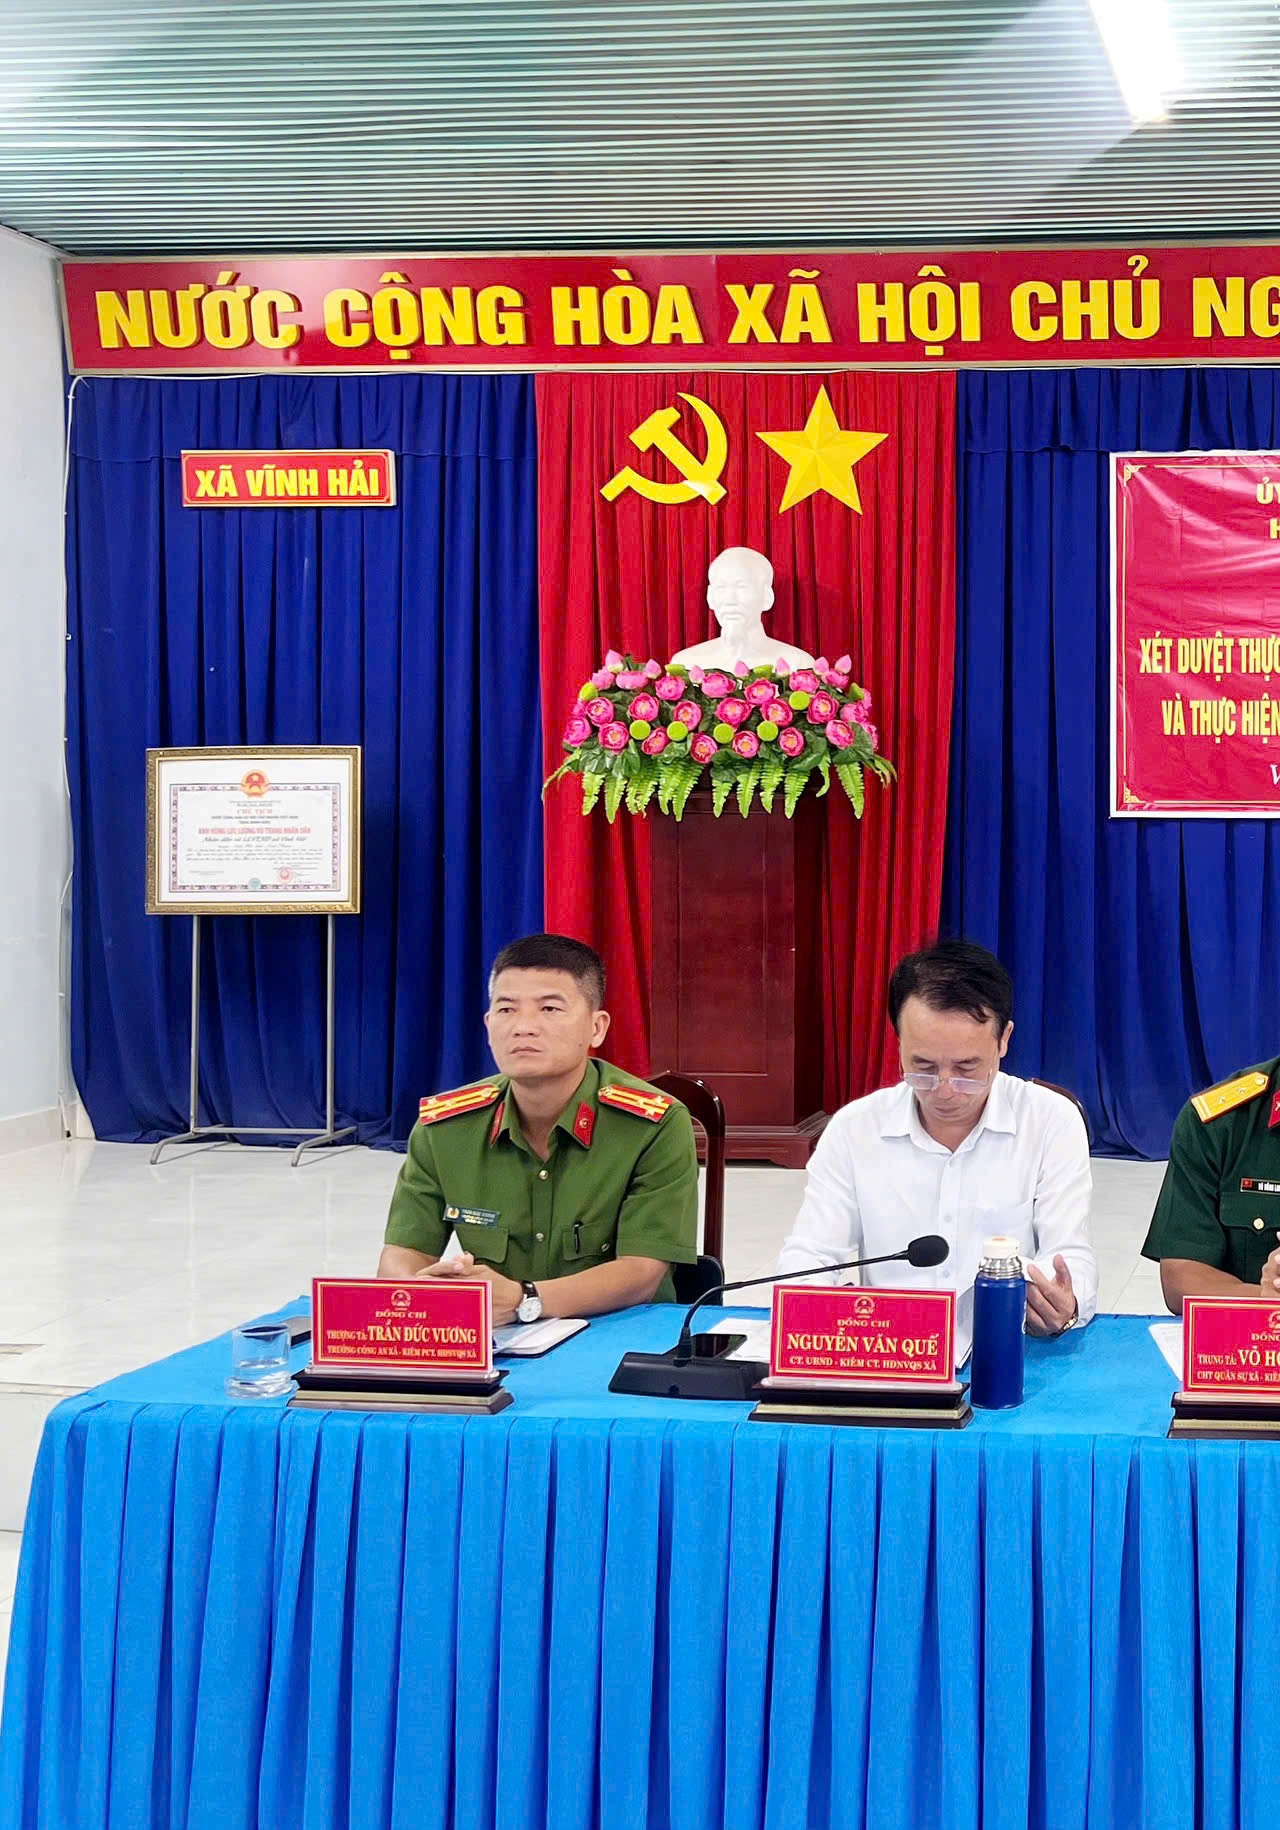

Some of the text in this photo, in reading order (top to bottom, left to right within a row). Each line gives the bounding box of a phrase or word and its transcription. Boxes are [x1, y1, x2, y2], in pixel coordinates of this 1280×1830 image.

[96, 272, 302, 350] NƯỚC
[323, 272, 526, 360] CỘNG
[552, 268, 704, 345] HÒA
[725, 268, 833, 344] XÃ
[858, 265, 981, 356] HỘI
[1010, 255, 1161, 342] CHỦ
[195, 457, 380, 499] XÃ VĨNH HẢI
[1139, 631, 1173, 674] XÉT
[1177, 630, 1235, 682] DUYỆT
[1161, 692, 1186, 736] VÀ
[1190, 697, 1237, 744] THỰC
[375, 1309, 428, 1320] ĐỒNG CHÍ
[837, 1318, 890, 1329] ĐỒNG CHÍ
[404, 1322, 430, 1342] ĐỨC
[433, 1325, 477, 1344] VƯƠNG
[787, 1327, 940, 1358] NGUYỄN VĂN QUẾ
[806, 1356, 833, 1366] UBND
[839, 1356, 865, 1368] KIÊM
[923, 1358, 937, 1371] XÃ
[1197, 1353, 1224, 1365] TRUNG
[1238, 1345, 1261, 1366] VÕ
[1214, 1369, 1236, 1382] QUÂN
